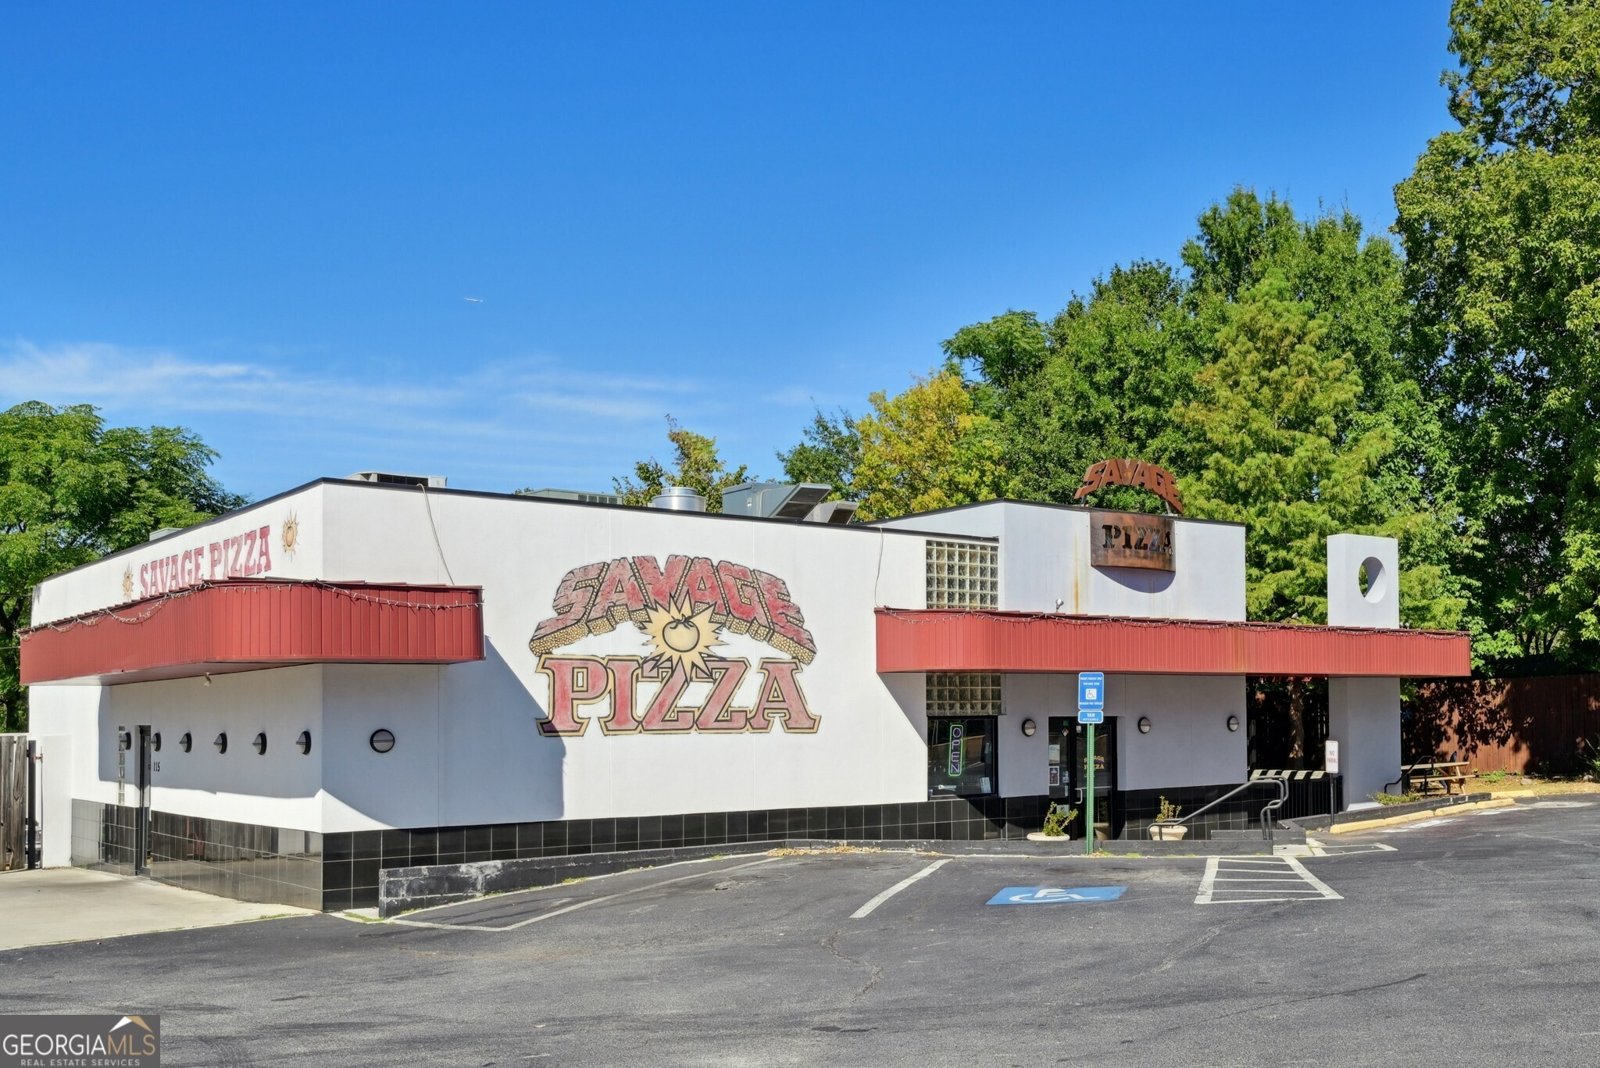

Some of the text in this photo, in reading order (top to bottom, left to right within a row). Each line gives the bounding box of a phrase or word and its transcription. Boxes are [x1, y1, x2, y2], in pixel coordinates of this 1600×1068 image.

[1074, 458, 1185, 514] SAVAGE
[140, 525, 272, 598] SAVAGE PIZZA
[1102, 524, 1174, 555] PIZZA
[529, 555, 818, 665] SAVAGE
[535, 654, 821, 736] PIZZA
[153, 761, 161, 772] 115
[951, 727, 962, 773] OPEN
